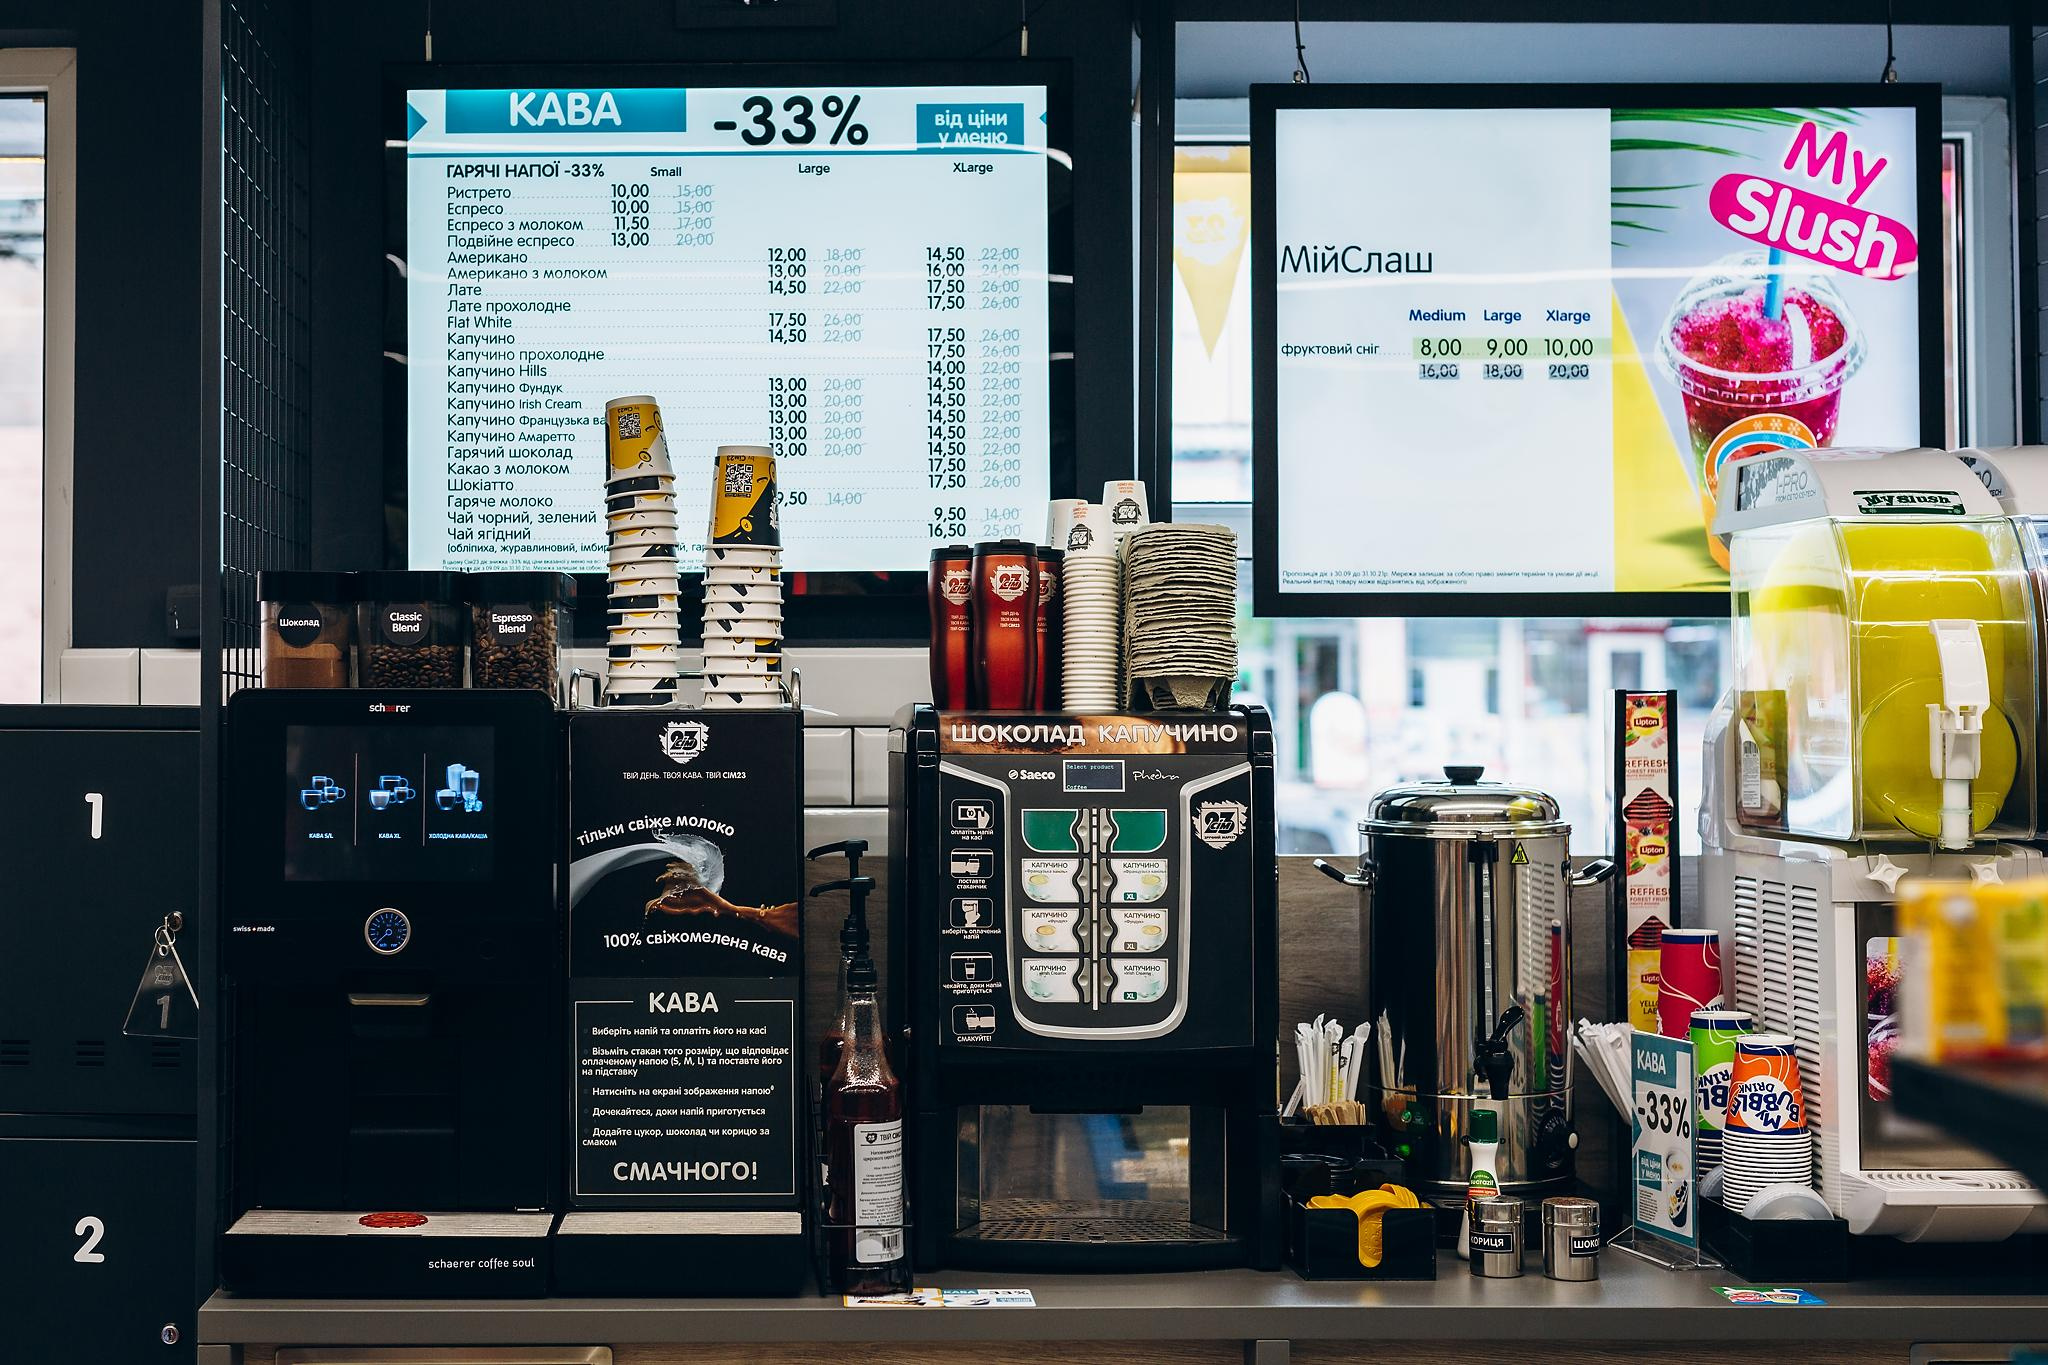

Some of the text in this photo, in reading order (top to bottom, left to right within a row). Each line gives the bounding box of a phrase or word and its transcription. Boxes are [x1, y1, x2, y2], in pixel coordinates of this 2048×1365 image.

[509, 91, 622, 126] КАВА
[713, 94, 869, 147] -33%
[935, 109, 1007, 128] від ціни
[939, 132, 1007, 149] у меню
[446, 161, 605, 178] ГАРЯЧІ НАПОЇ -33%
[798, 163, 830, 175] Large
[953, 162, 993, 175] XLarge
[1784, 122, 1887, 205] My
[650, 167, 682, 177] Small
[448, 187, 511, 200] Ристрето
[611, 184, 649, 199] 10,00
[448, 204, 503, 216] Еспресо
[611, 201, 649, 215] 10,00
[448, 220, 583, 233] Еспресо з молоком
[614, 217, 649, 232] 11,50
[1728, 178, 1897, 275] Slush
[448, 235, 574, 249] Подвійне еспресо
[612, 233, 649, 247] 13,00
[448, 252, 528, 265] Американо
[768, 248, 806, 263] 12,00
[927, 248, 964, 262] 14,50
[1280, 246, 1432, 273] МійСлаш
[448, 268, 607, 282] Американо з молоком
[768, 265, 806, 279] 13,00
[927, 264, 964, 279] 16,00
[448, 285, 481, 296] Лате
[768, 281, 806, 295] 14,50
[448, 317, 511, 328] Flat White
[769, 313, 806, 328] 17,50
[1409, 310, 1590, 323] Medium Large Xlarge
[448, 333, 515, 350] Капучино
[928, 329, 965, 343] 17,50
[1281, 339, 1593, 359] фруктовий сніг 8,00 9,00 10,00
[448, 350, 605, 365] Капучино прохолодне
[448, 365, 547, 381] Капучино Hills
[928, 361, 965, 376] 14,00
[448, 382, 562, 397] Капучино Фундук
[769, 378, 806, 393] 13,00
[448, 398, 582, 413] Капучино Irish Cream
[448, 415, 589, 429] Капучино Французька
[448, 431, 575, 445] Капучино Амаретто
[448, 446, 573, 461] Гарячий шоколад
[448, 463, 569, 475] Какао з молоком
[448, 479, 513, 491] Шокіатто
[448, 512, 597, 527] Чай чорний, зелений
[934, 507, 966, 521] 9,50
[448, 528, 531, 542] Чай ягідний
[928, 524, 966, 538] 16,50
[280, 618, 319, 628] Шоколад
[390, 612, 422, 622] Classic
[492, 614, 532, 626] Espresso
[392, 622, 420, 632] Blend
[499, 623, 526, 633] Blend
[1635, 719, 1657, 727] Lipton
[952, 724, 1238, 746] ШОКОЛАД КАПУЧИНО
[623, 771, 638, 779] ТВІЙ
[706, 771, 721, 779] ТВІЙ
[1020, 770, 1055, 780] Saeco
[85, 793, 103, 839] 1
[629, 815, 671, 832] свіже
[676, 816, 735, 837] молоко
[1641, 847, 1663, 855] Lipton
[604, 930, 787, 963] 100% свіжомелена кава
[650, 992, 718, 1013] КАВА
[157, 996, 170, 1029] 1
[593, 1027, 658, 1036] Виберіть напій
[957, 1034, 992, 1042] СМАКУЙТЕ!
[593, 1047, 628, 1055] Візьміть
[582, 1058, 637, 1067] оплаченому
[1637, 1049, 1666, 1075] КАВА
[596, 1068, 638, 1077] підставку
[593, 1087, 636, 1096] Натисніть
[1739, 1082, 1775, 1093] DRINK
[593, 1107, 653, 1117] Дочекайтеся,
[1730, 1091, 1799, 1122] BUBBLE
[1637, 1090, 1690, 1139] -33%
[593, 1128, 664, 1137] Додайте цукор,
[613, 1161, 757, 1181] СМАЧНОГО!
[74, 1216, 104, 1262] 2
[1574, 1237, 1599, 1248] ШОКО
[429, 1257, 534, 1270] schaerer coffee soul
